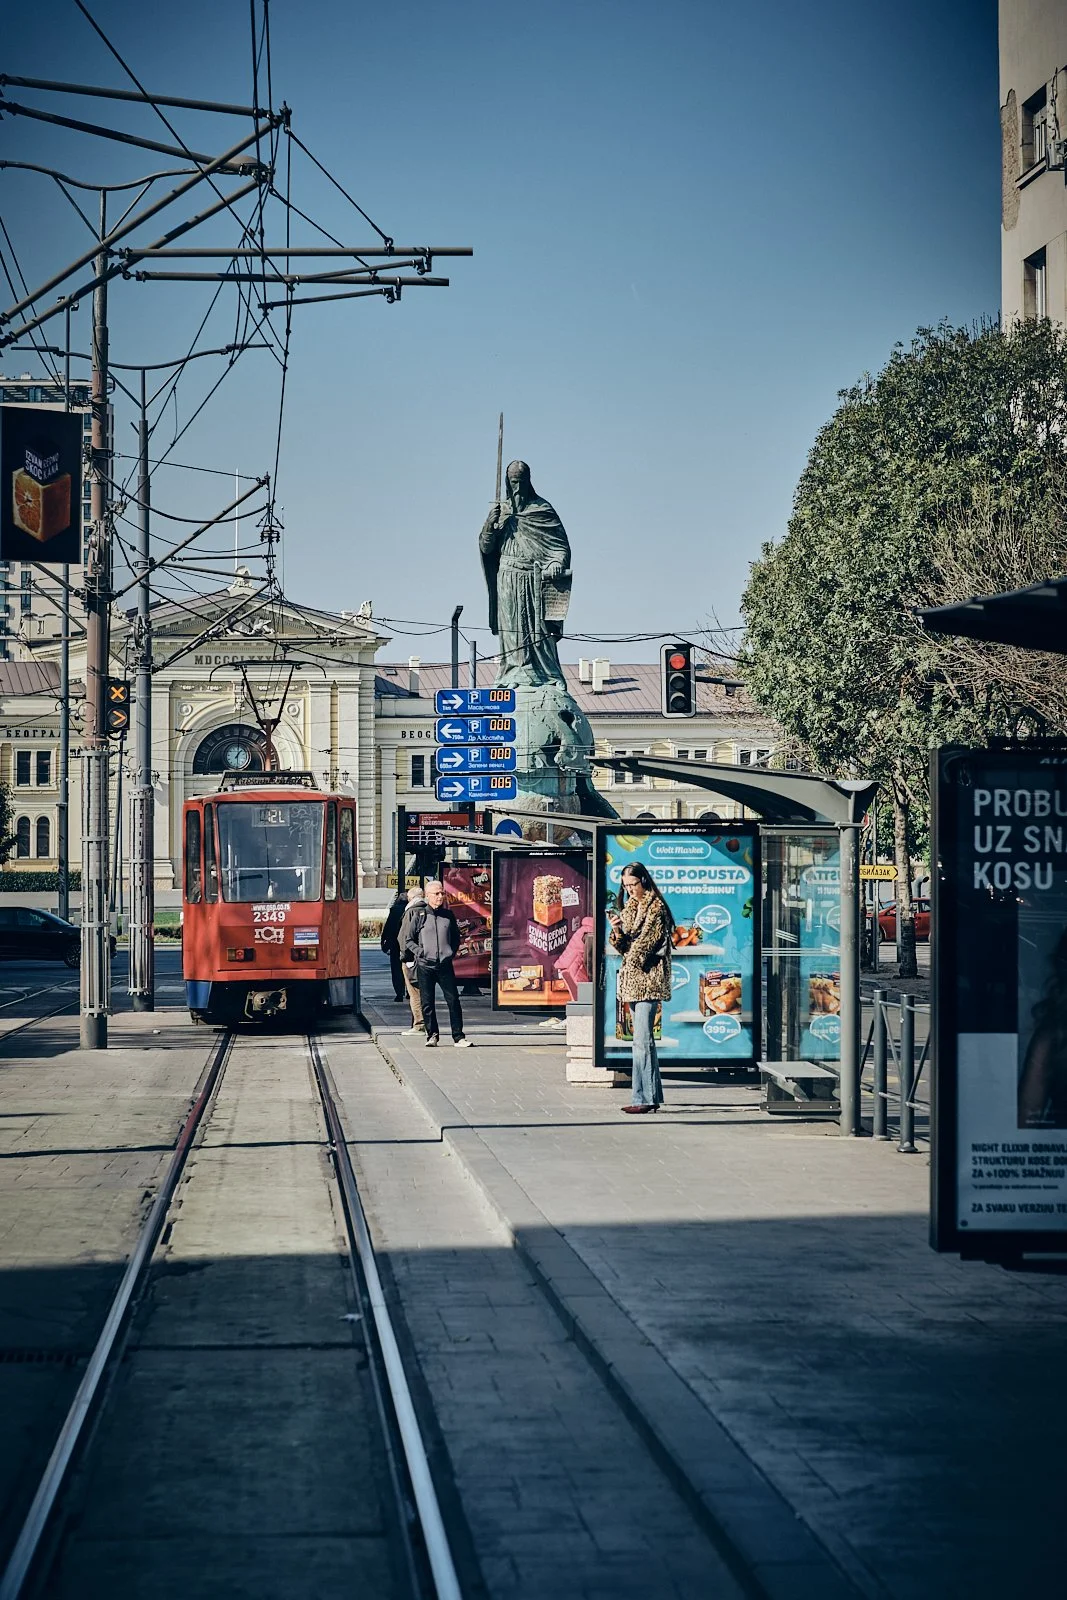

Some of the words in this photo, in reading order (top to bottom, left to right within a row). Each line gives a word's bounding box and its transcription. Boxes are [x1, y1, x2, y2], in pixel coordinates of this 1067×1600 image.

[490, 690, 511, 702] 008
[489, 719, 511, 731] 000
[6, 729, 61, 738] БЕОГРА
[490, 748, 511, 760] 000
[490, 777, 512, 789] 005
[974, 825, 1012, 853] UZ
[1023, 825, 1067, 853] SN
[656, 845, 675, 854] Wolt
[674, 845, 704, 854] Market
[677, 869, 746, 880] POPUSTA
[973, 861, 1054, 890] KOSU
[668, 883, 735, 894] PORUDŽBINU!
[253, 911, 286, 923] 2349
[698, 916, 717, 925] 539
[528, 925, 547, 940] IZVAN
[528, 934, 548, 951] SKOC
[548, 934, 567, 951] KANA
[706, 1025, 726, 1034] 399
[971, 1142, 999, 1153] NIGHT
[971, 1155, 1026, 1165] STRUKTURU
[971, 1168, 984, 1178] ZA
[985, 1168, 1020, 1178] +100%
[971, 1202, 984, 1213] ZA
[985, 1202, 1016, 1213] SVAKU
